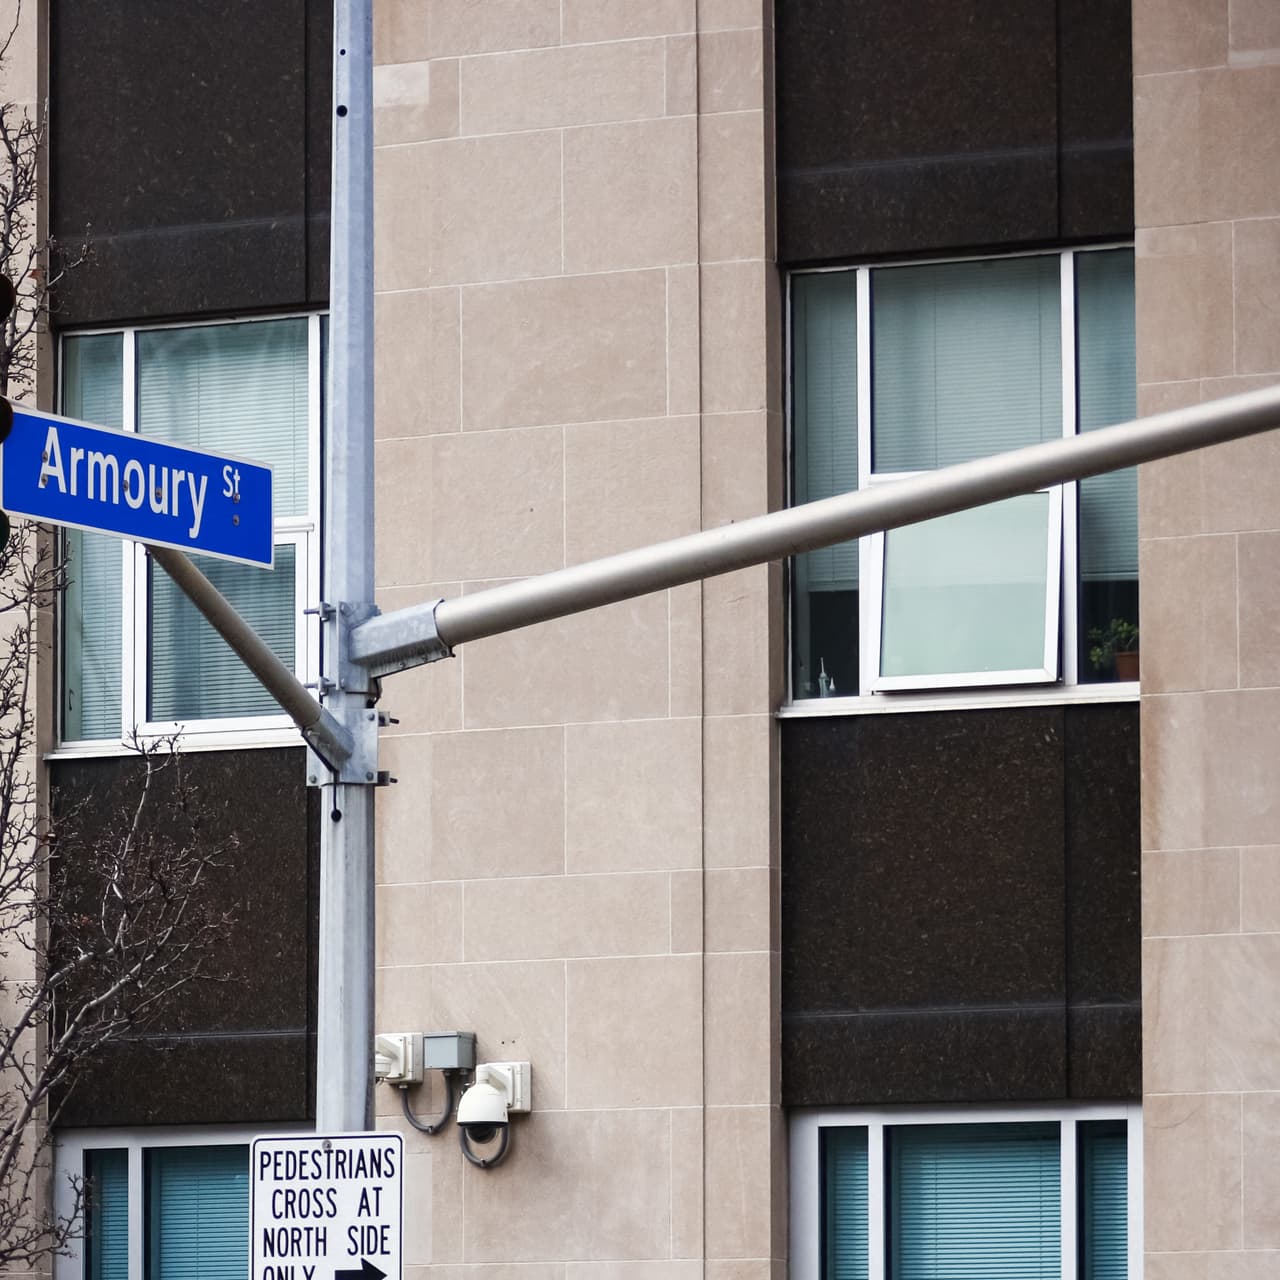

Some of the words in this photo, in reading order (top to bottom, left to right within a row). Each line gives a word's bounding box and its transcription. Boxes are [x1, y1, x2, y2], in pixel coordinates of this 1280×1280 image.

[38, 426, 208, 539] Armoury
[223, 464, 241, 501] St
[260, 1147, 395, 1181] PEDESTRIANS
[271, 1188, 338, 1219] CROSS
[357, 1186, 383, 1218] AT
[263, 1226, 328, 1258] NORTH
[346, 1225, 391, 1256] SIDE
